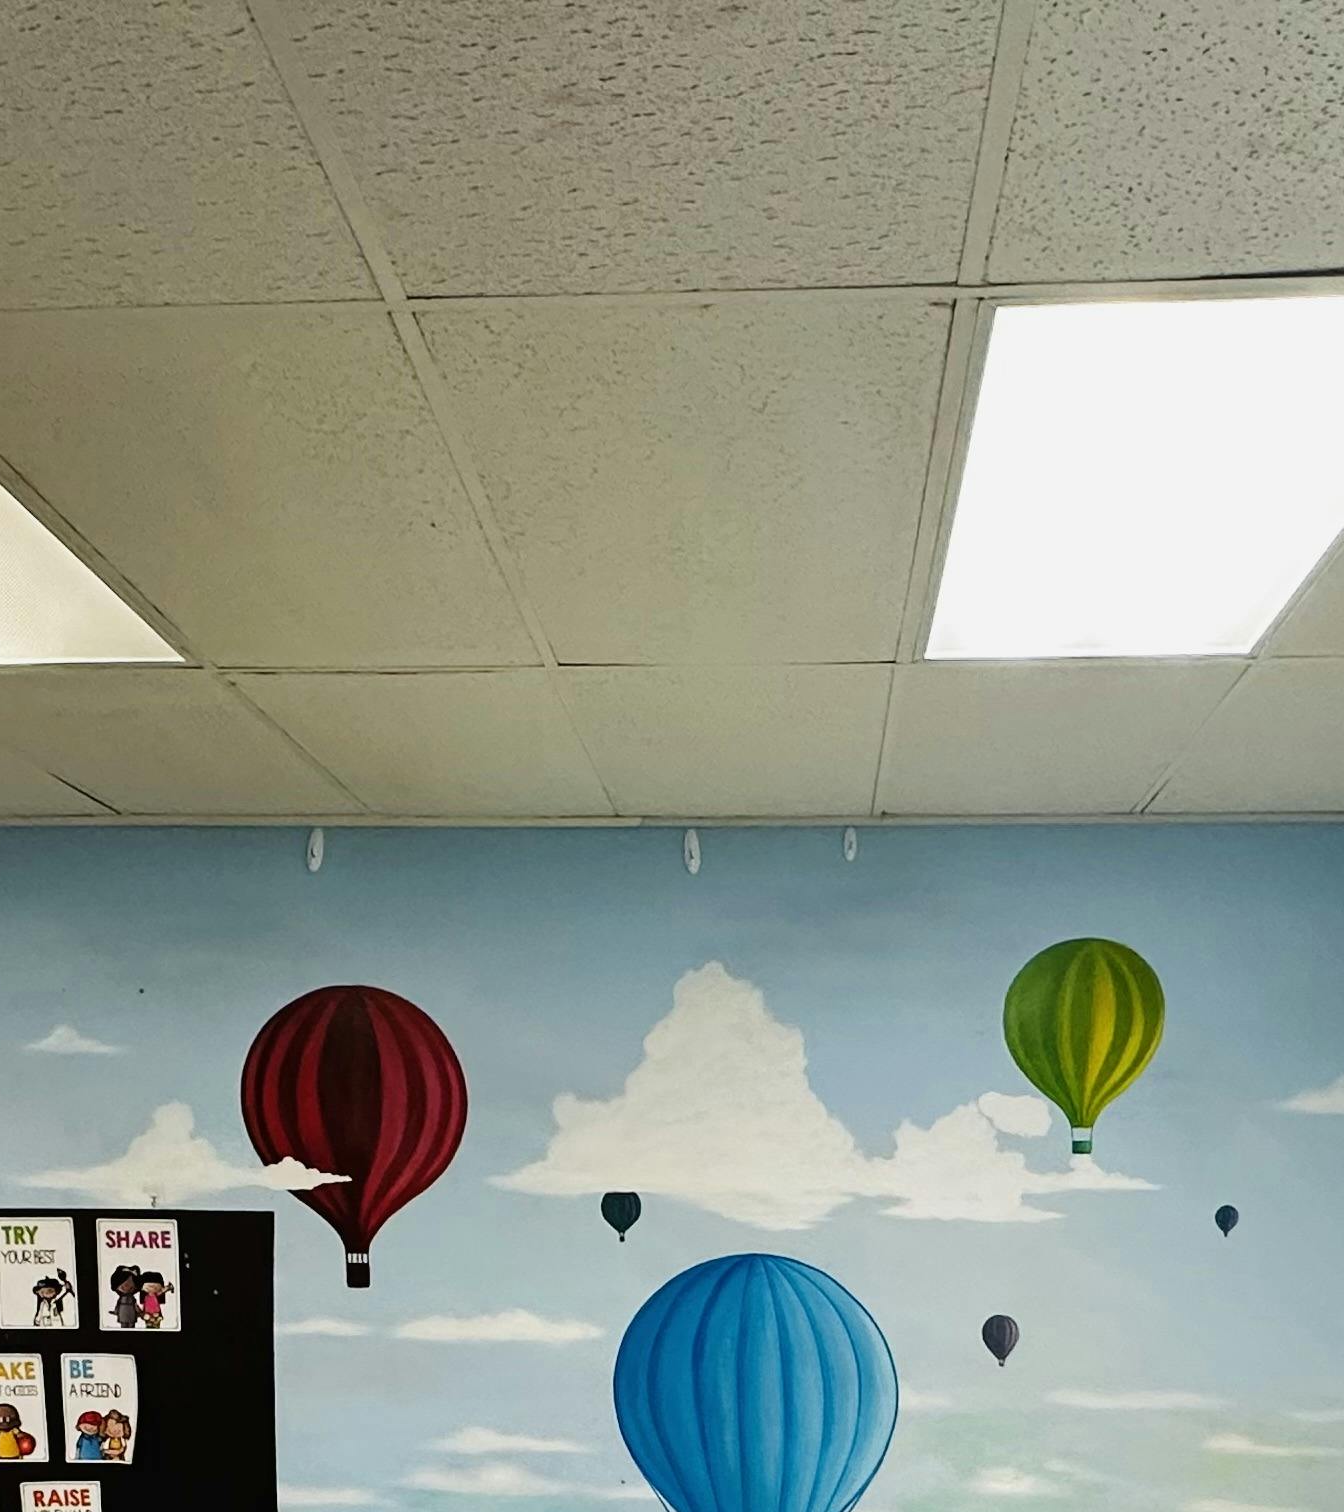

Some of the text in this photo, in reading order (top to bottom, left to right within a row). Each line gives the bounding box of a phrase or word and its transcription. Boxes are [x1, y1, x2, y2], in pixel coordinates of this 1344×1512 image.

[1, 1226, 38, 1245] TRY
[106, 1230, 172, 1249] SHARE
[1, 1249, 56, 1264] YOUR BEST
[70, 1359, 95, 1379] BE
[6, 1385, 38, 1396] CHOICES
[70, 1382, 122, 1398] A FRIEND
[33, 1489, 91, 1507] RAISE
